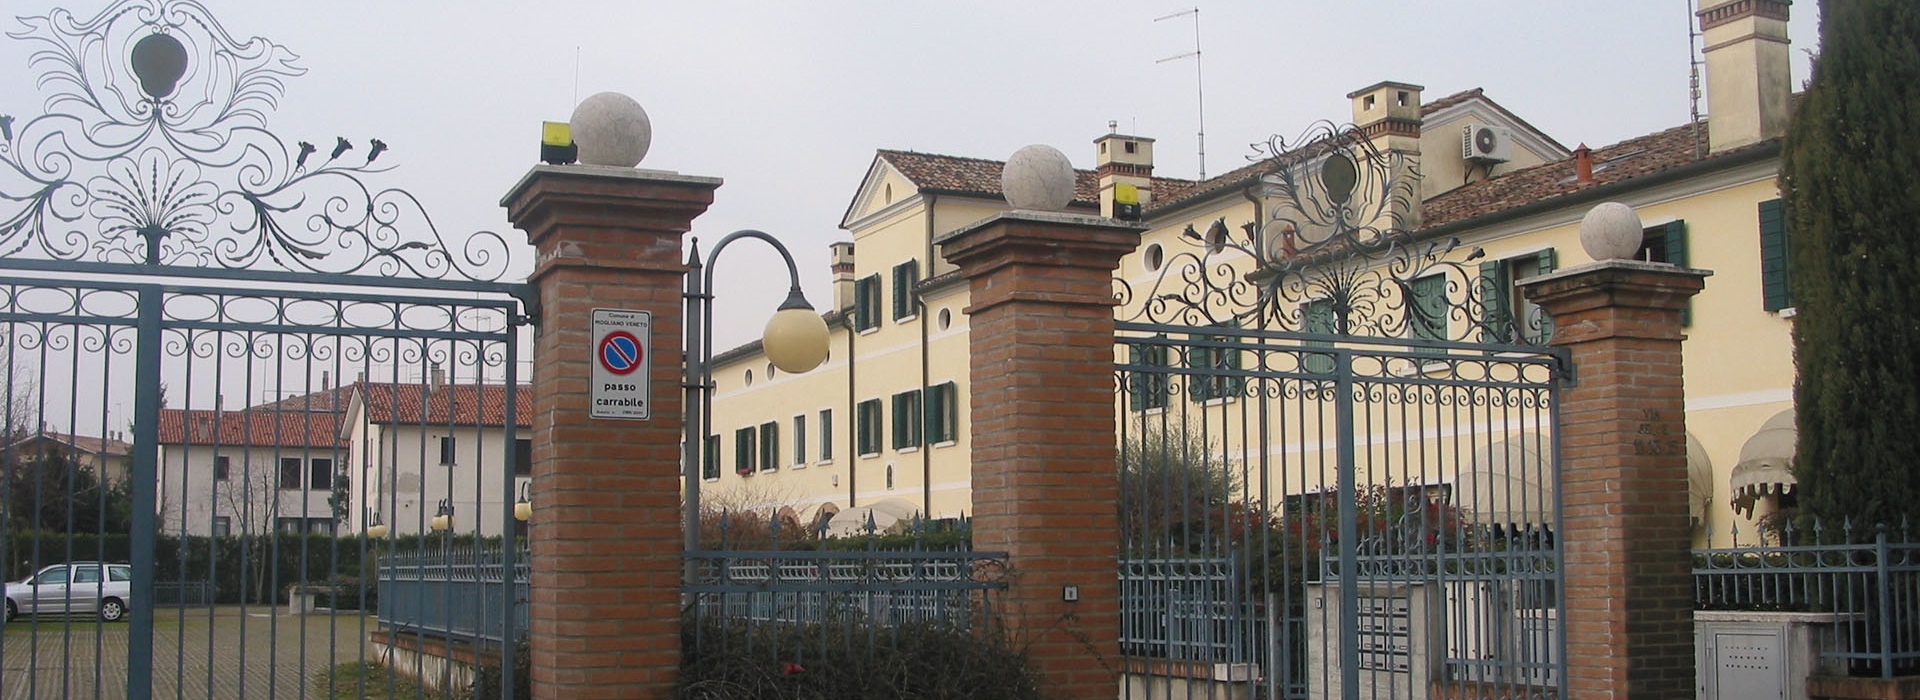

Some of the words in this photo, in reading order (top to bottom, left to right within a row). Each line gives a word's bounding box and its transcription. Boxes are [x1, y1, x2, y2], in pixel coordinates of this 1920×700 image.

[595, 319, 624, 327] MOGLIANO
[604, 383, 636, 392] passo
[596, 398, 644, 407] carrabile
